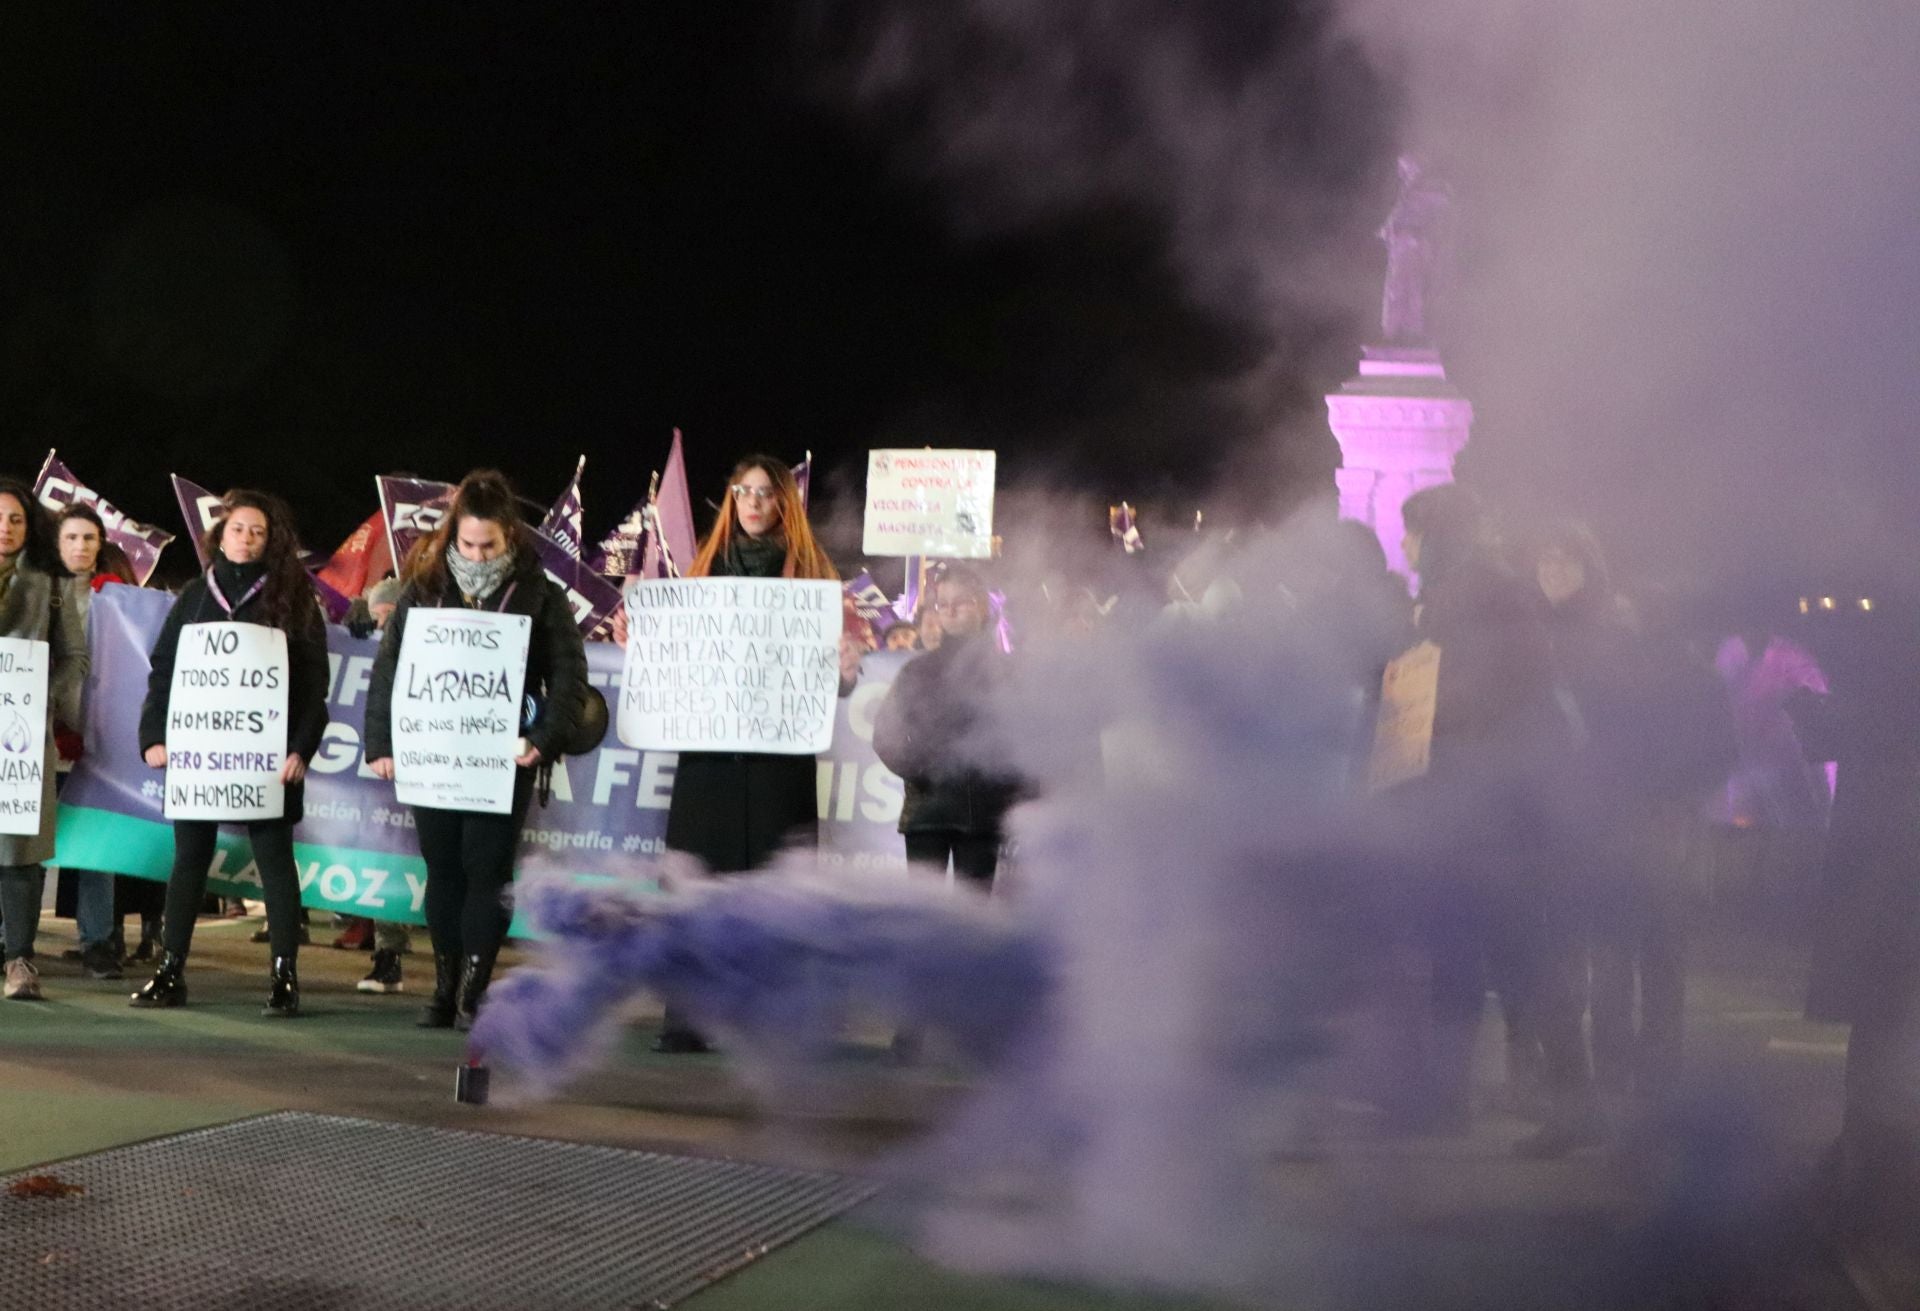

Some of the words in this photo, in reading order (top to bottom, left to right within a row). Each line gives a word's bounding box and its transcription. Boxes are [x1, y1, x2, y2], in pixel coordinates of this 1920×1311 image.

[723, 583, 745, 611] DE
[753, 584, 787, 611] LOS
[793, 584, 825, 612] QUE
[782, 615, 821, 640] VAN
[631, 640, 645, 662] A
[744, 641, 759, 665] A
[181, 667, 230, 688] TODOS
[240, 666, 280, 689] LOS
[408, 663, 434, 702] LA
[734, 667, 775, 690] QUE
[781, 670, 796, 691] A
[626, 690, 717, 714] MUJERES
[725, 690, 769, 715] NOS
[781, 692, 826, 717] HAN
[399, 716, 423, 734] QUE
[428, 719, 455, 732] NOS
[662, 714, 727, 742] HECHO
[169, 751, 202, 770] PERO
[207, 751, 279, 772] SIEMPRE
[453, 756, 463, 770] A
[0, 798, 38, 817] MBRE
[171, 784, 189, 807] UN
[194, 783, 267, 809] HOMBRE
